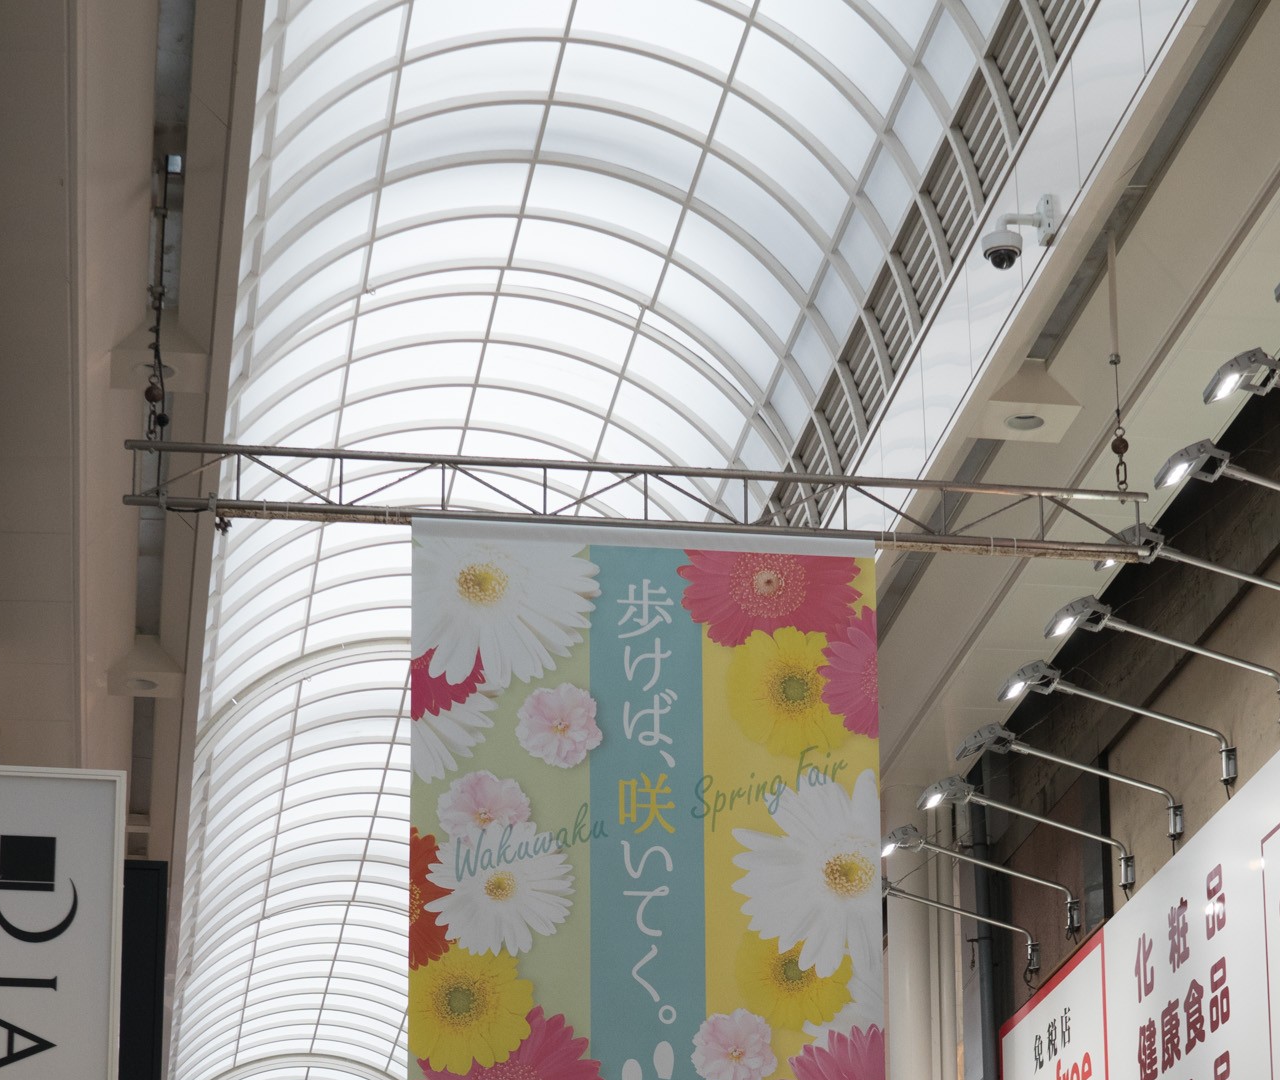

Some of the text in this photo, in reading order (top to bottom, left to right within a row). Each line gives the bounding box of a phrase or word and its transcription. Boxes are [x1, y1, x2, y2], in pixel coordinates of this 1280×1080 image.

[453, 804, 609, 883] Wakuwaku
[616, 578, 677, 1026] 歩けば、咲いてく。
[691, 745, 848, 831] Spring Fair
[1133, 862, 1226, 1005] 化粧品
